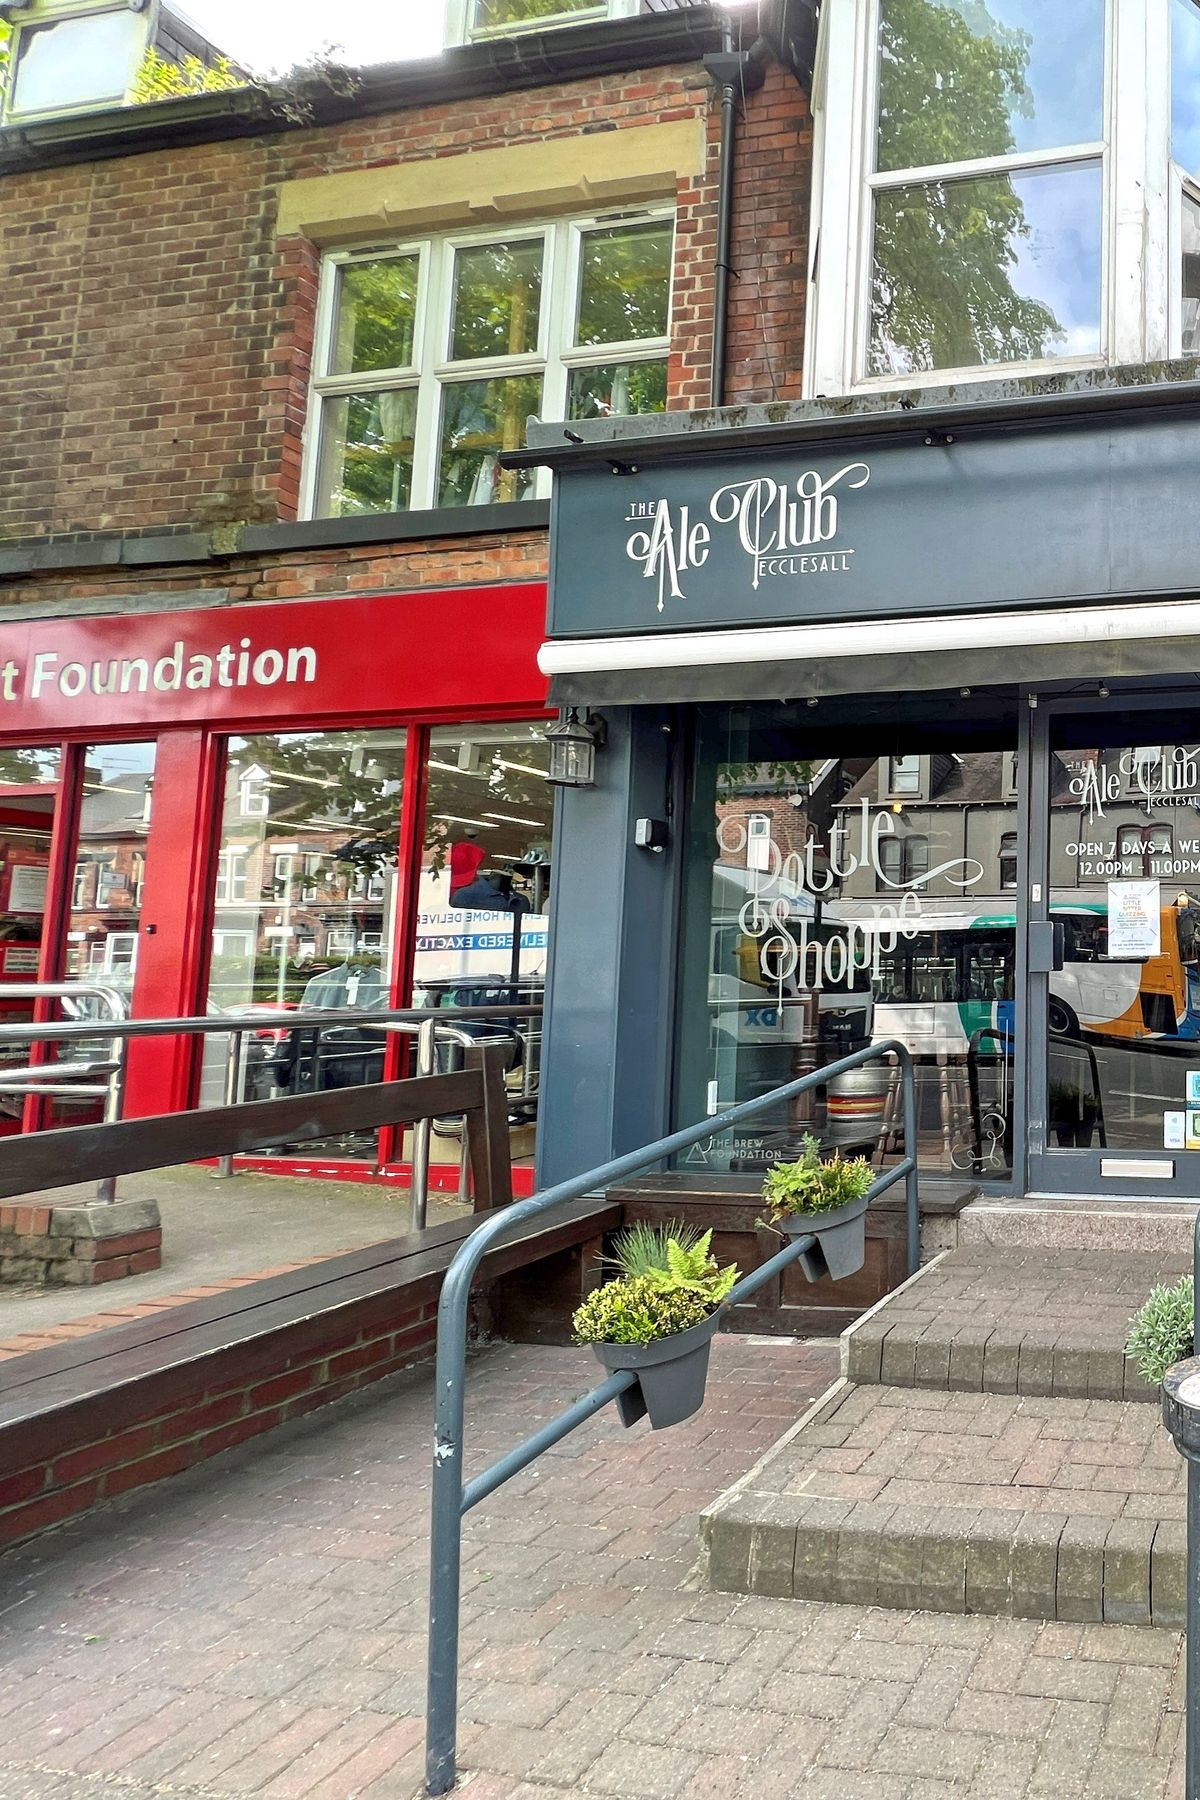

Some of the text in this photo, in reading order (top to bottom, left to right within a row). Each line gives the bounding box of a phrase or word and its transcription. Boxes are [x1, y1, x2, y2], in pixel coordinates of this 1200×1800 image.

[630, 502, 656, 517] THE
[626, 463, 871, 613] Ale Club
[758, 554, 851, 577] ECCLESALL
[30, 637, 318, 699] Foundation
[1069, 760, 1121, 826] Ale
[716, 797, 985, 900] Bottle
[1065, 842, 1104, 857] OPEN
[1108, 842, 1117, 857] 7
[1121, 840, 1156, 855] DAYS
[1161, 841, 1173, 854] A
[1079, 861, 1133, 875] 12.00PM
[1150, 859, 1200, 874] 11.00PM
[738, 891, 923, 1016] Shoppe
[710, 1149, 782, 1160] FOUNDATION
[711, 1138, 764, 1149] THE BREW
